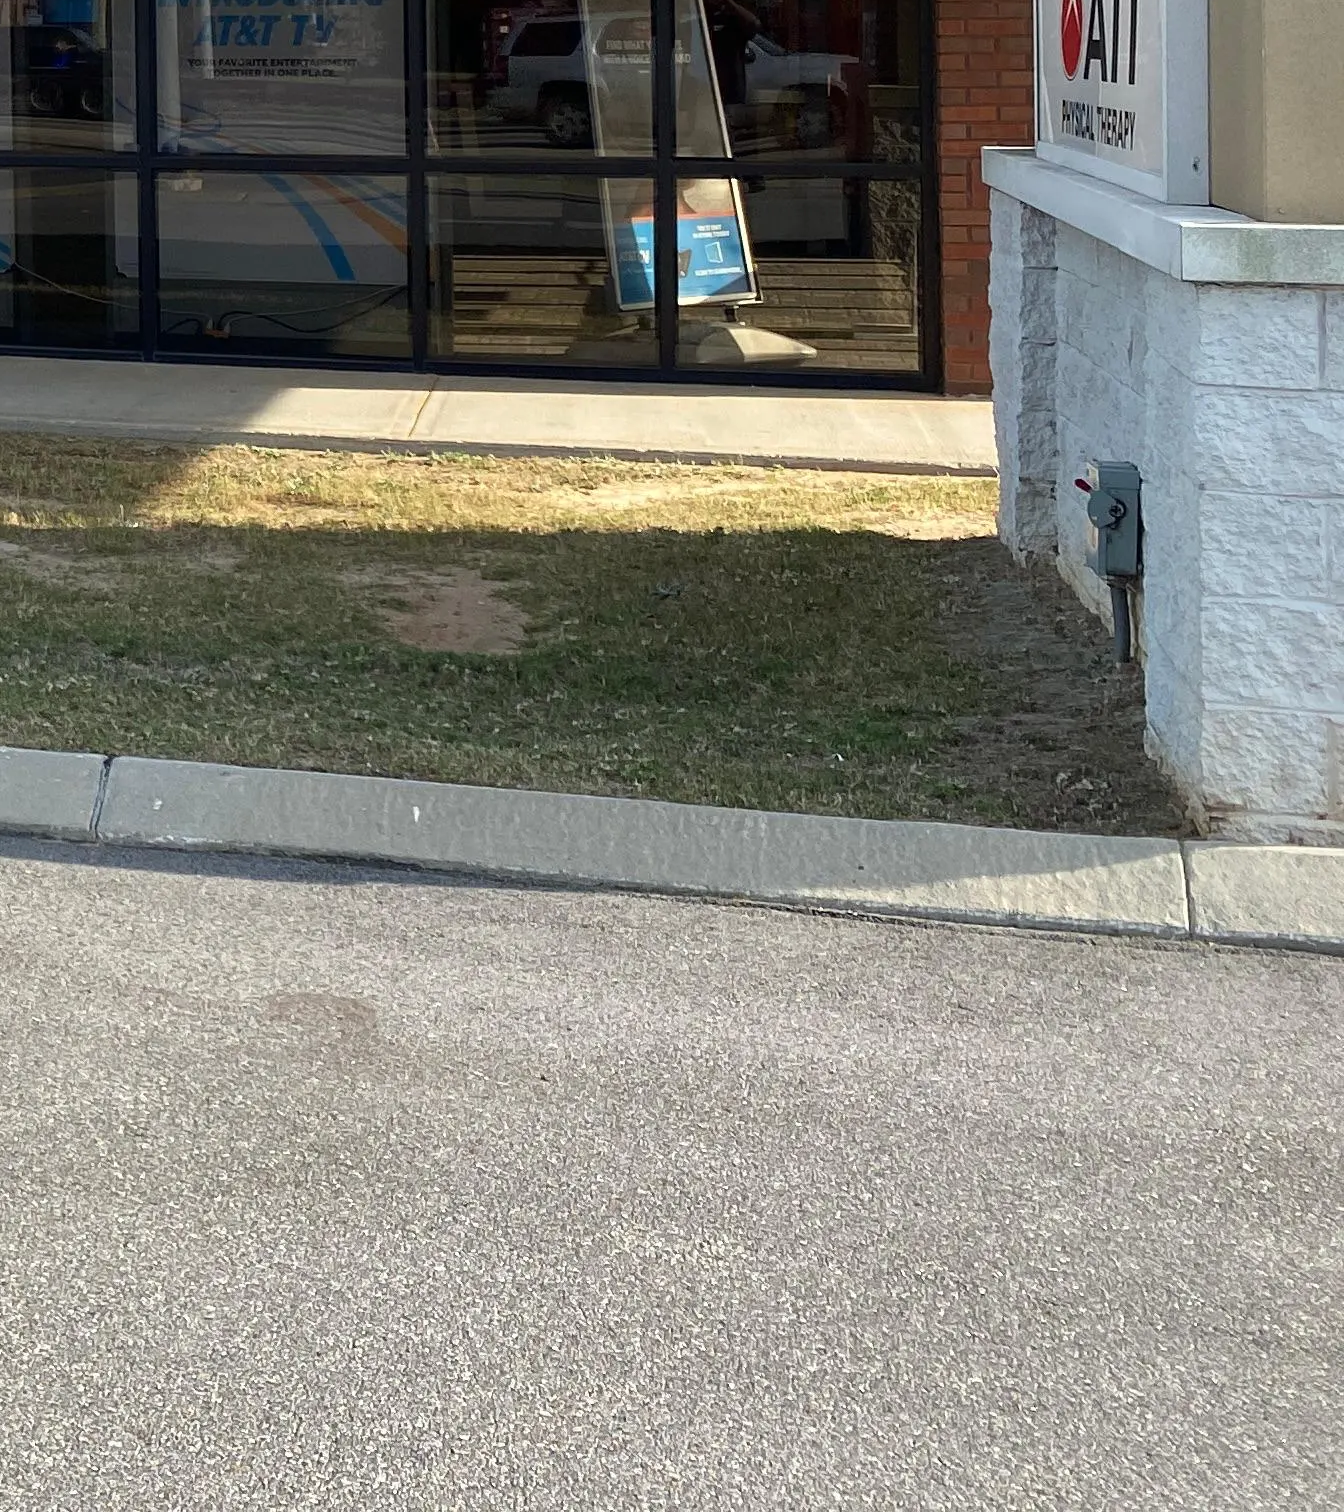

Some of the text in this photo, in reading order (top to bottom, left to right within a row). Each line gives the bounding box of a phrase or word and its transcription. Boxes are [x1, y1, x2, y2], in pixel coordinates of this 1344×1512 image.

[194, 15, 282, 46] AT&T
[218, 58, 268, 67] FAVORITE
[212, 69, 261, 78] OGETHER
[263, 69, 275, 78] IN
[277, 69, 298, 78] ONE
[1062, 99, 1136, 151] PHYSICAL THERAPY
